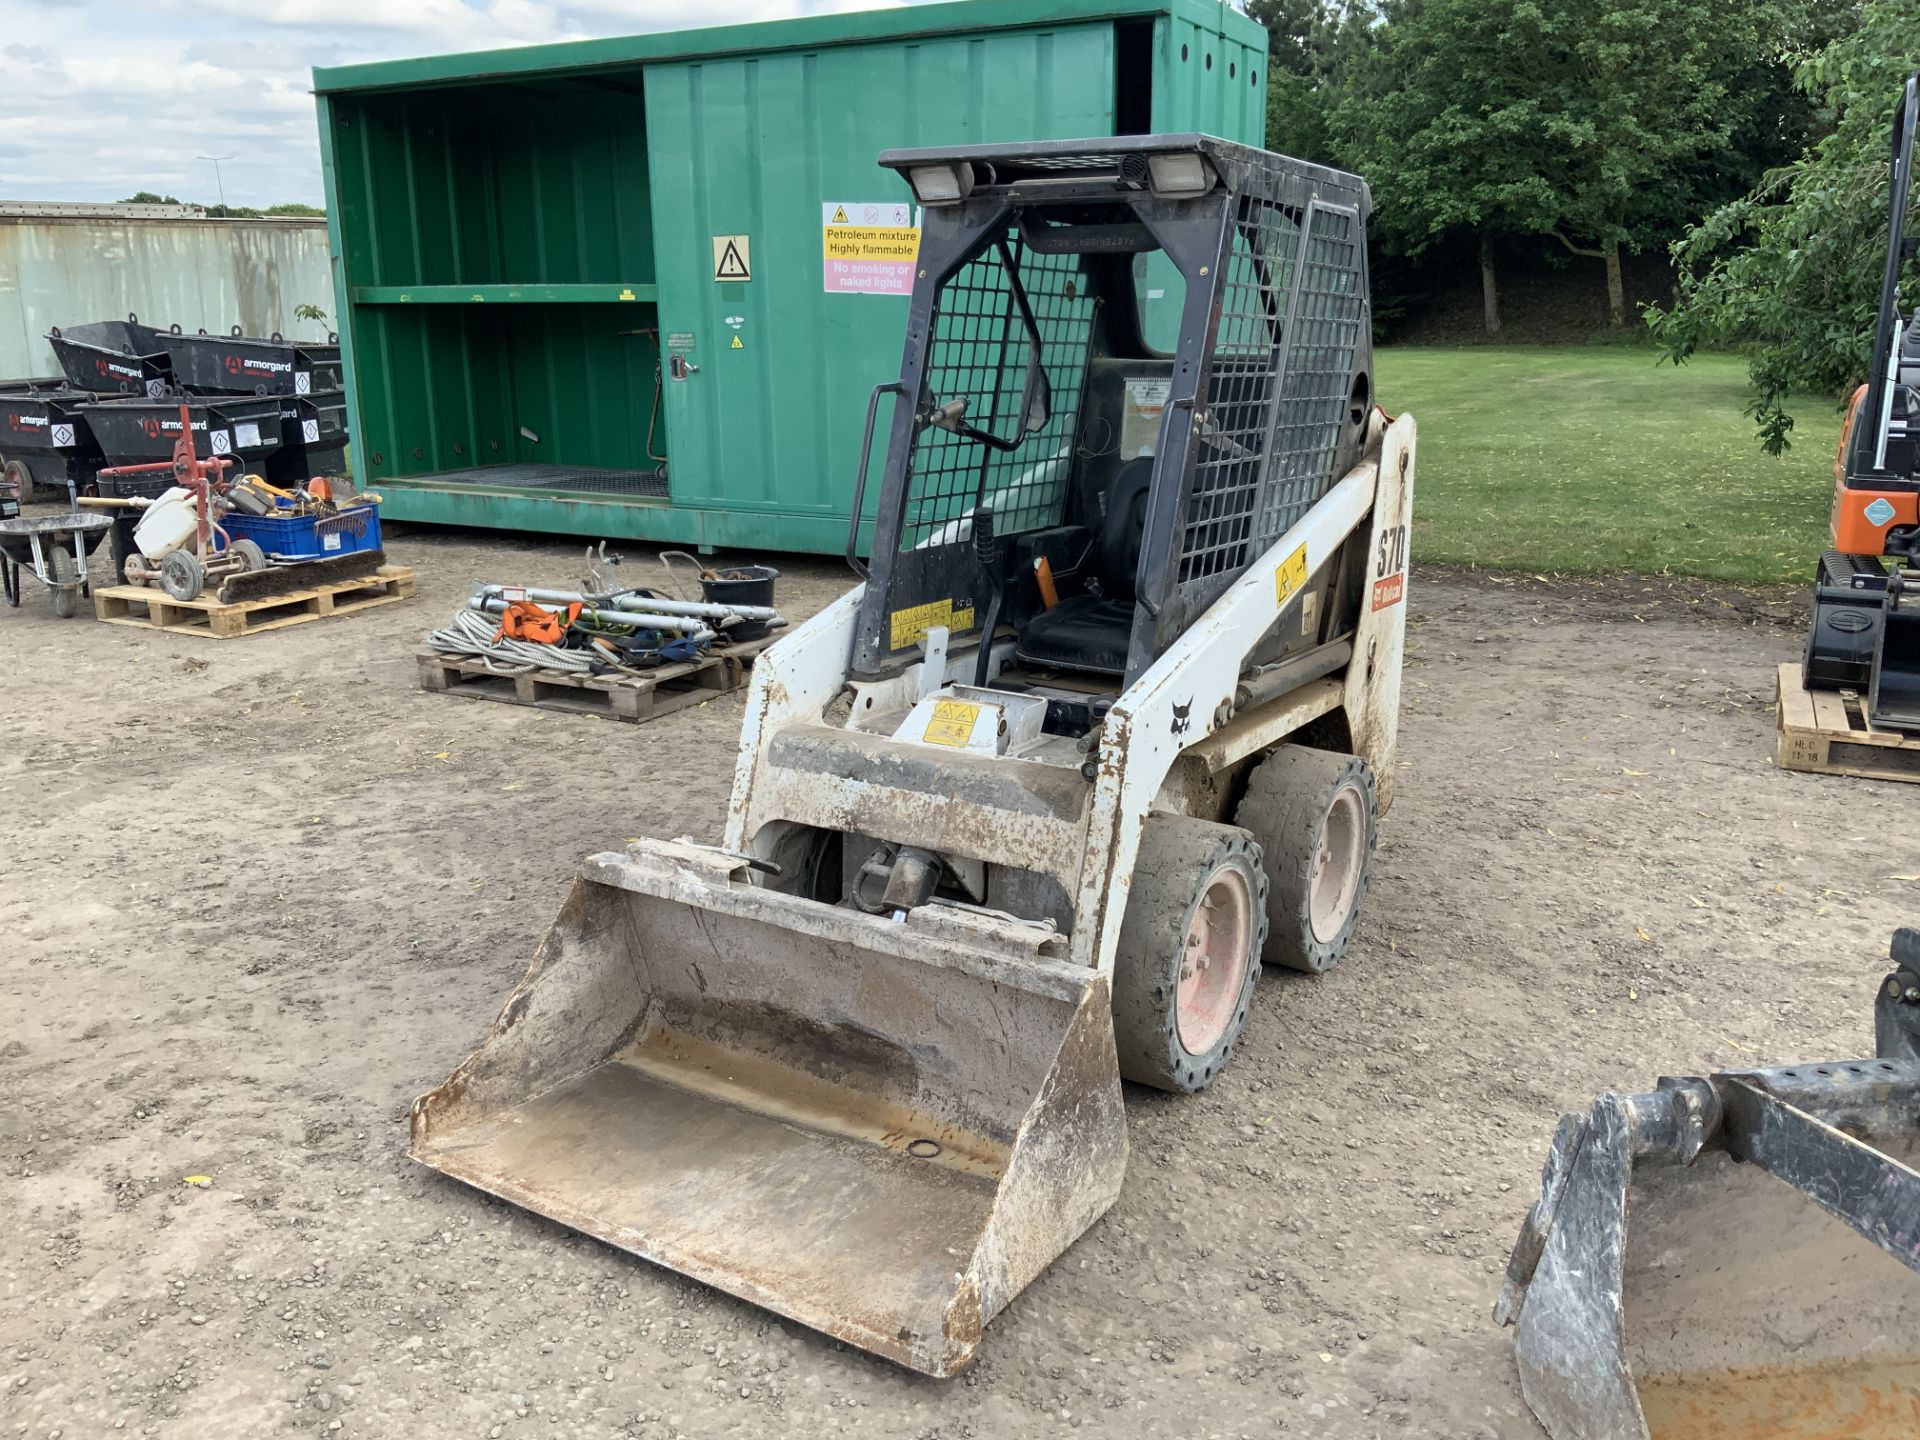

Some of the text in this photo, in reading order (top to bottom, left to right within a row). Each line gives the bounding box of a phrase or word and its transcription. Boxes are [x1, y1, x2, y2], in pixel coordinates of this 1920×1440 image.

[827, 229, 917, 241] Petroleum mixture
[830, 243, 913, 255] Highly flammable
[833, 262, 910, 276] No smoking or
[840, 276, 903, 290] naked lights
[108, 362, 143, 379] armorgard
[244, 359, 292, 373] armorgard
[19, 415, 49, 426] armorgard
[161, 420, 208, 431] armoard
